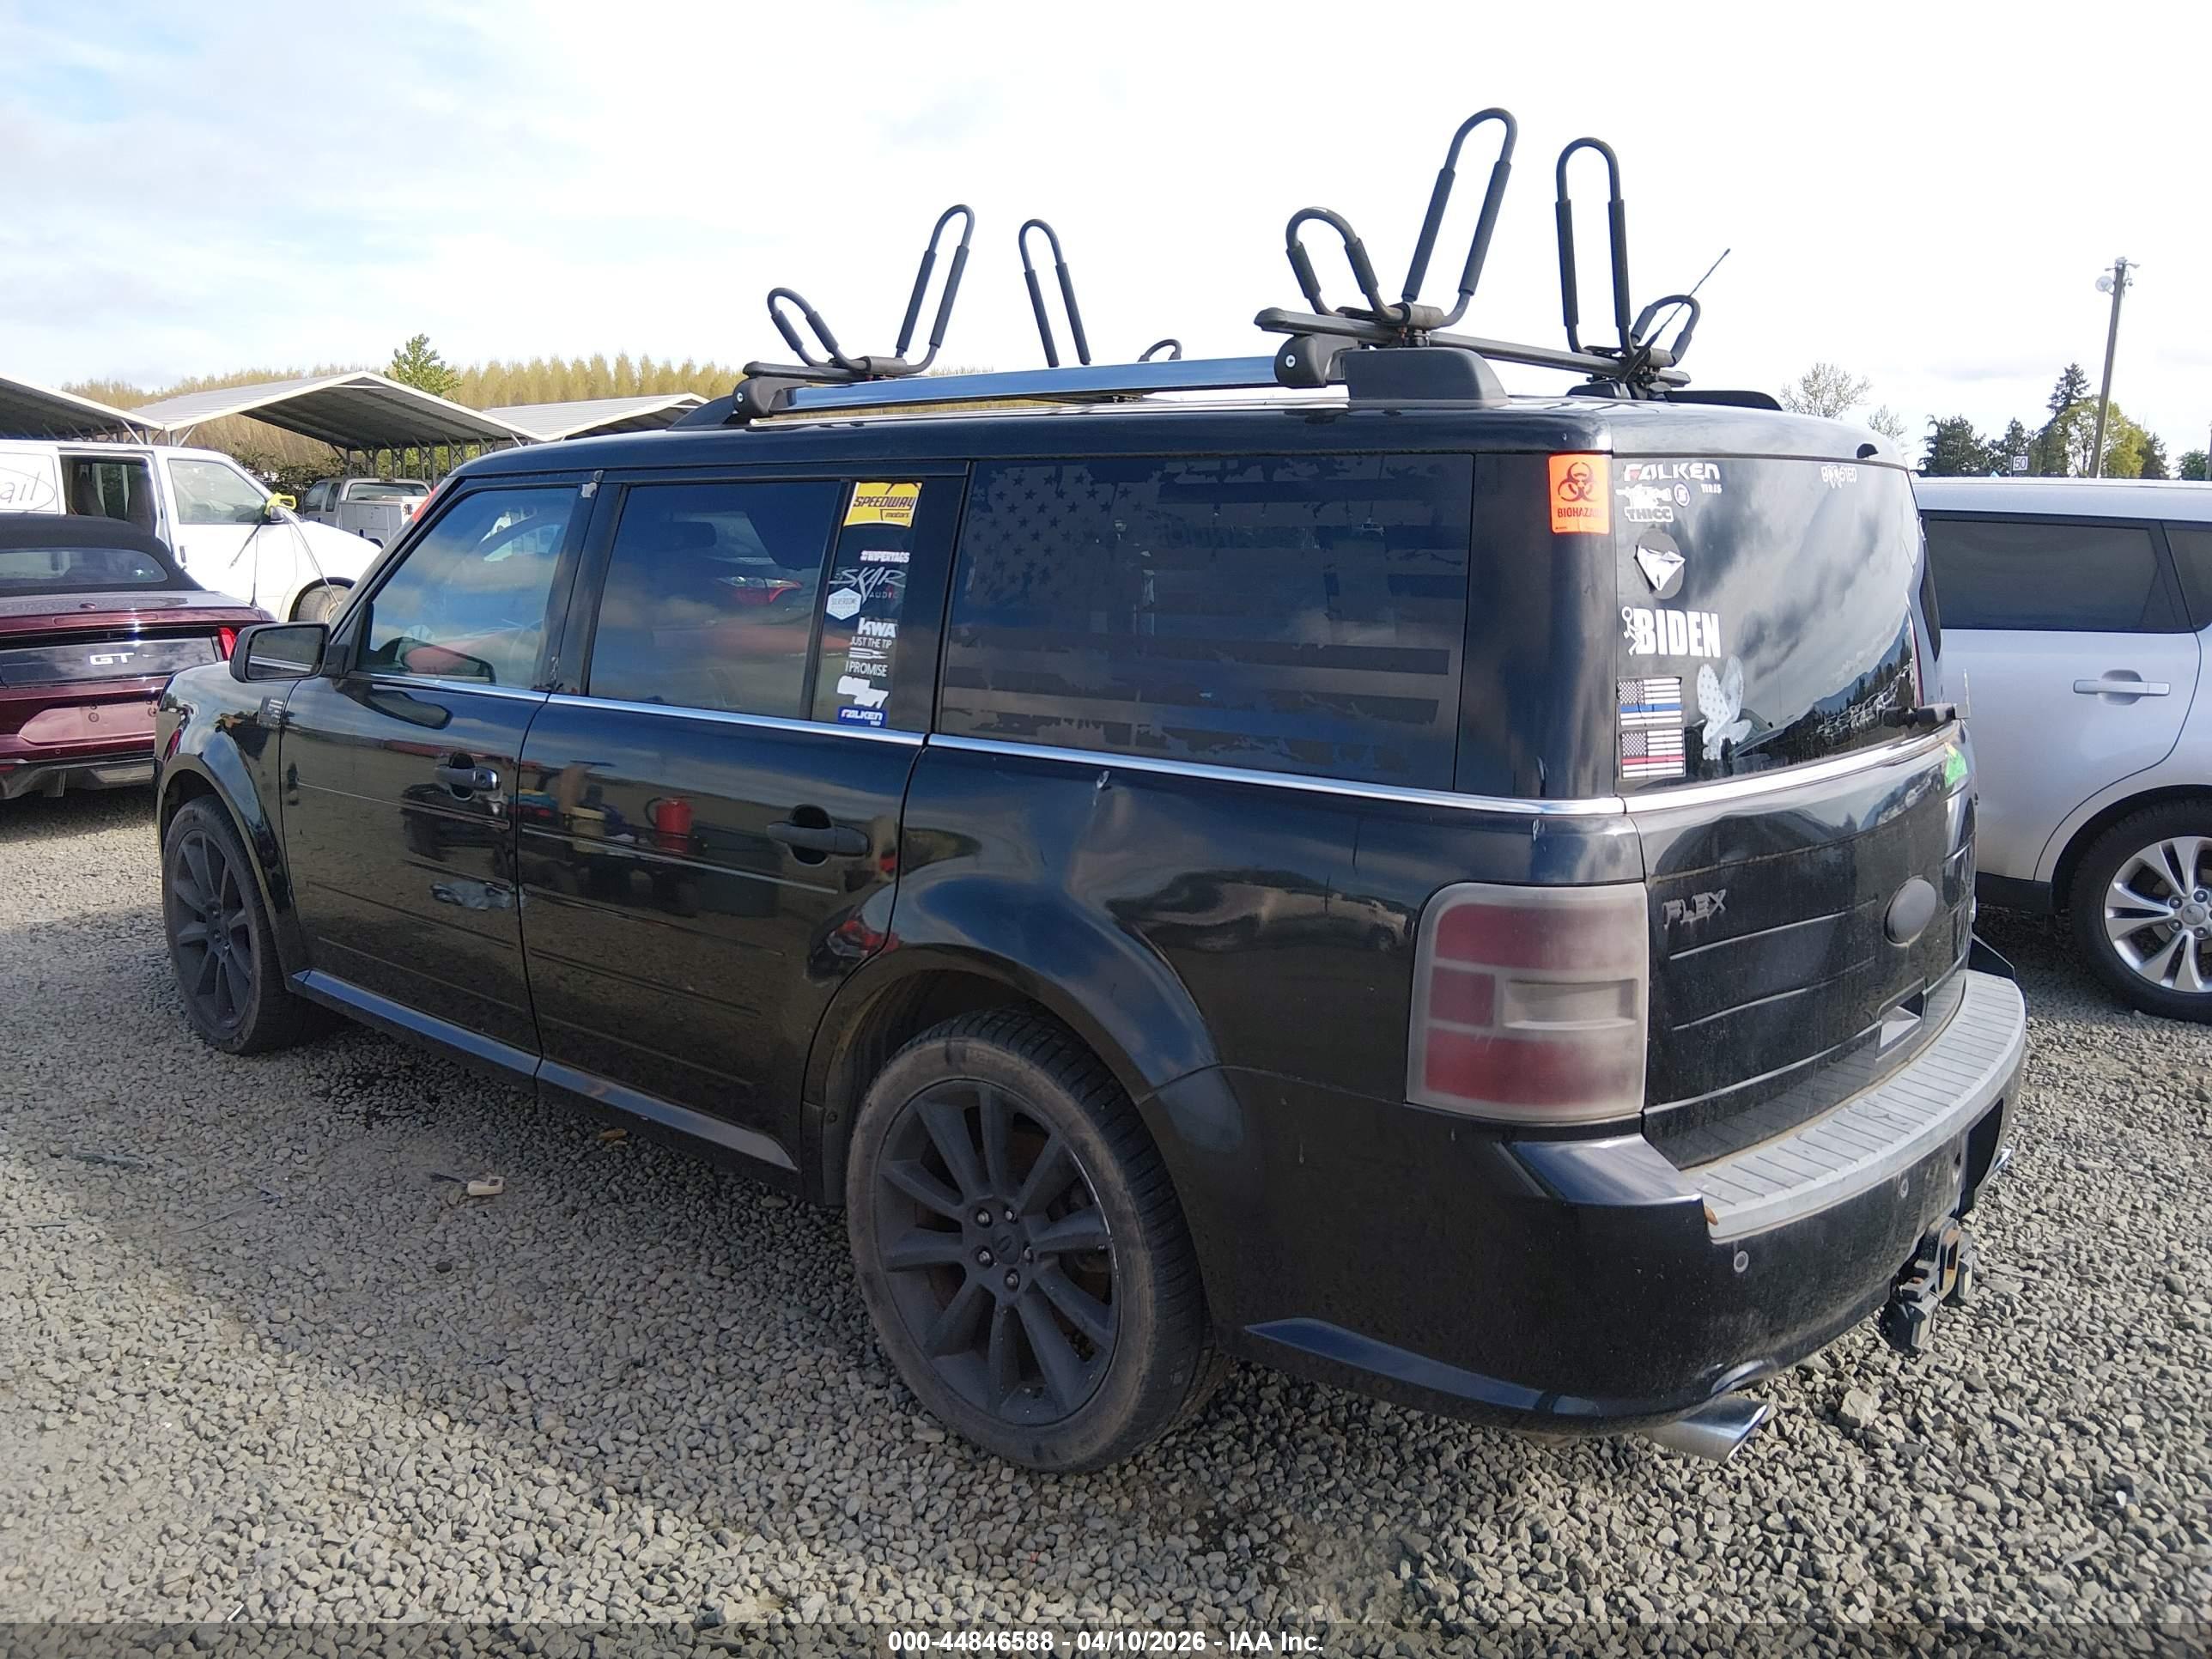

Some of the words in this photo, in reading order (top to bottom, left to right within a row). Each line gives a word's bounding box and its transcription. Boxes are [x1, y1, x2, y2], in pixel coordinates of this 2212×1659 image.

[2014, 457, 2027, 470] 50
[1624, 463, 1721, 481] FALKEN
[1701, 483, 1723, 495] TIRES
[853, 496, 916, 509] SPEEDWAY
[1626, 507, 1673, 520] THICC
[829, 567, 906, 605] SKAR
[857, 617, 896, 638] KWA
[1633, 607, 1721, 658] BIDEN
[850, 636, 866, 647] JUST
[866, 638, 881, 648] THE
[882, 639, 892, 649] TIP
[89, 652, 135, 665] GT
[849, 661, 888, 677] PROMISE
[841, 708, 883, 720] FALKEN
[1662, 889, 1727, 928] FLEX
